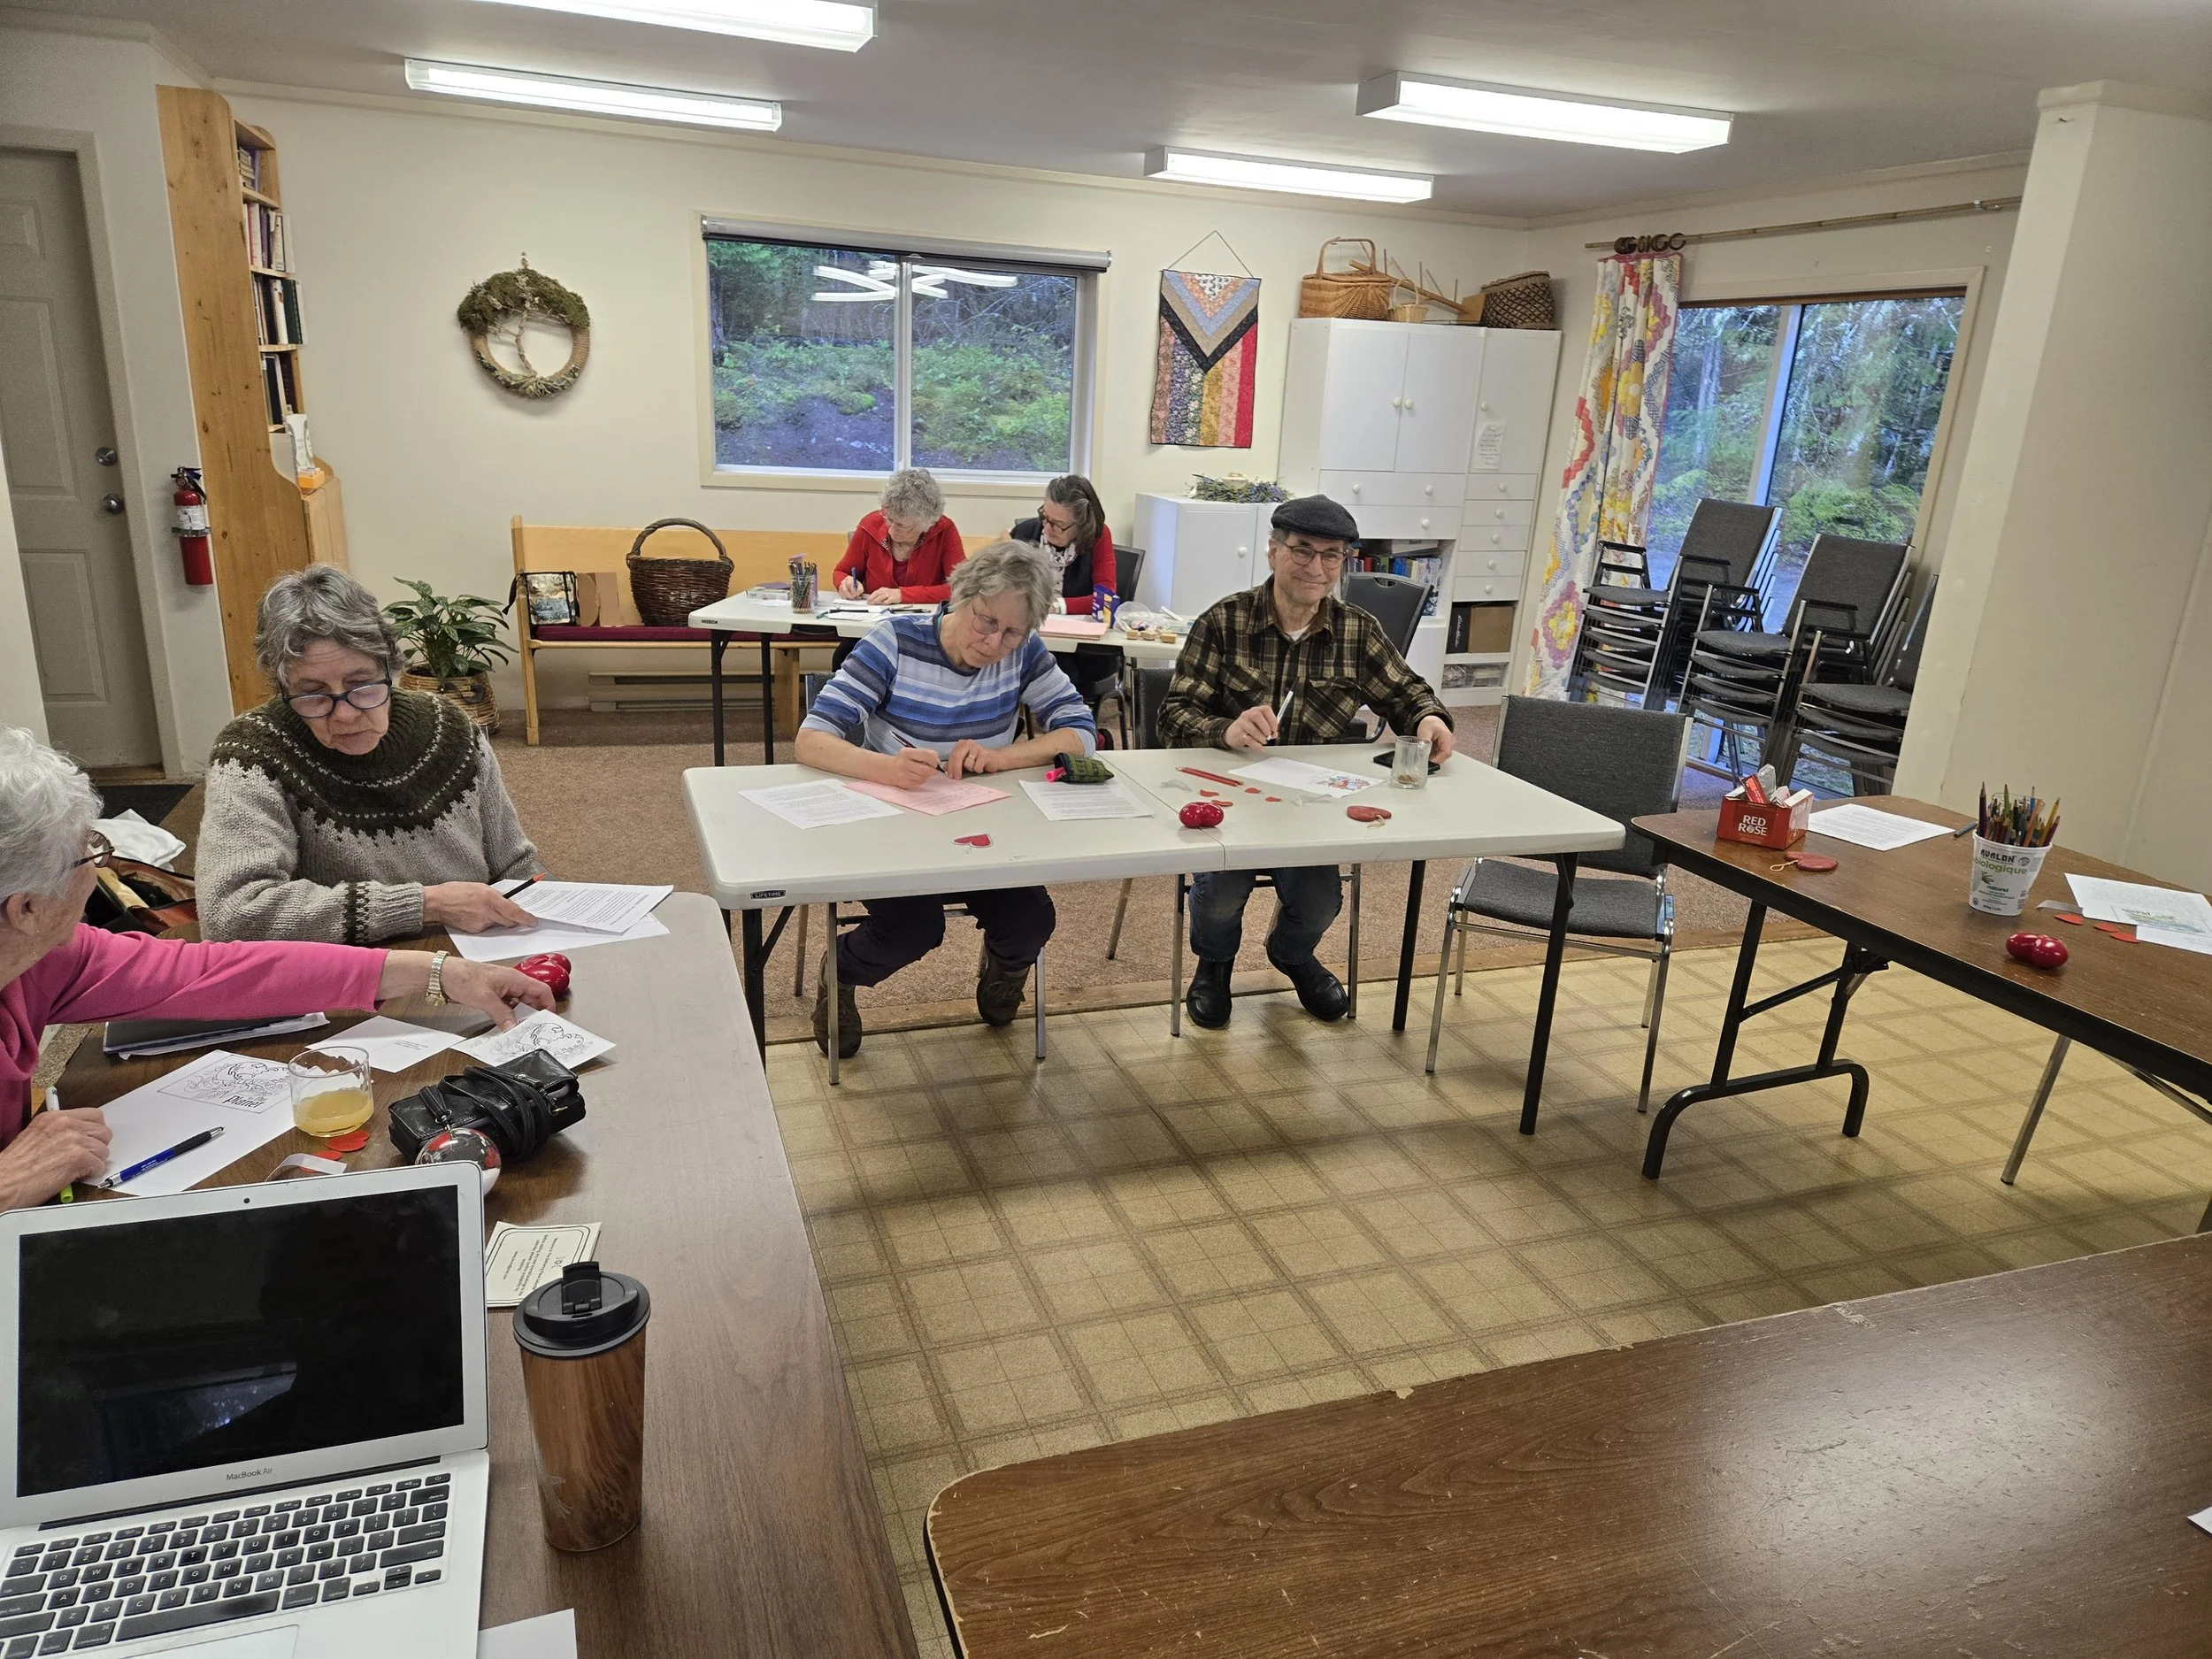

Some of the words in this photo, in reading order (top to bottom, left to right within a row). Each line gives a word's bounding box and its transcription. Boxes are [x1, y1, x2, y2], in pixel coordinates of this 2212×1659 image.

[1743, 814, 1766, 826] RED
[1738, 822, 1767, 836] ROSE
[1981, 849, 2015, 863] AVALON
[1975, 856, 2028, 875] biologique
[227, 1469, 261, 1480] MacBook
